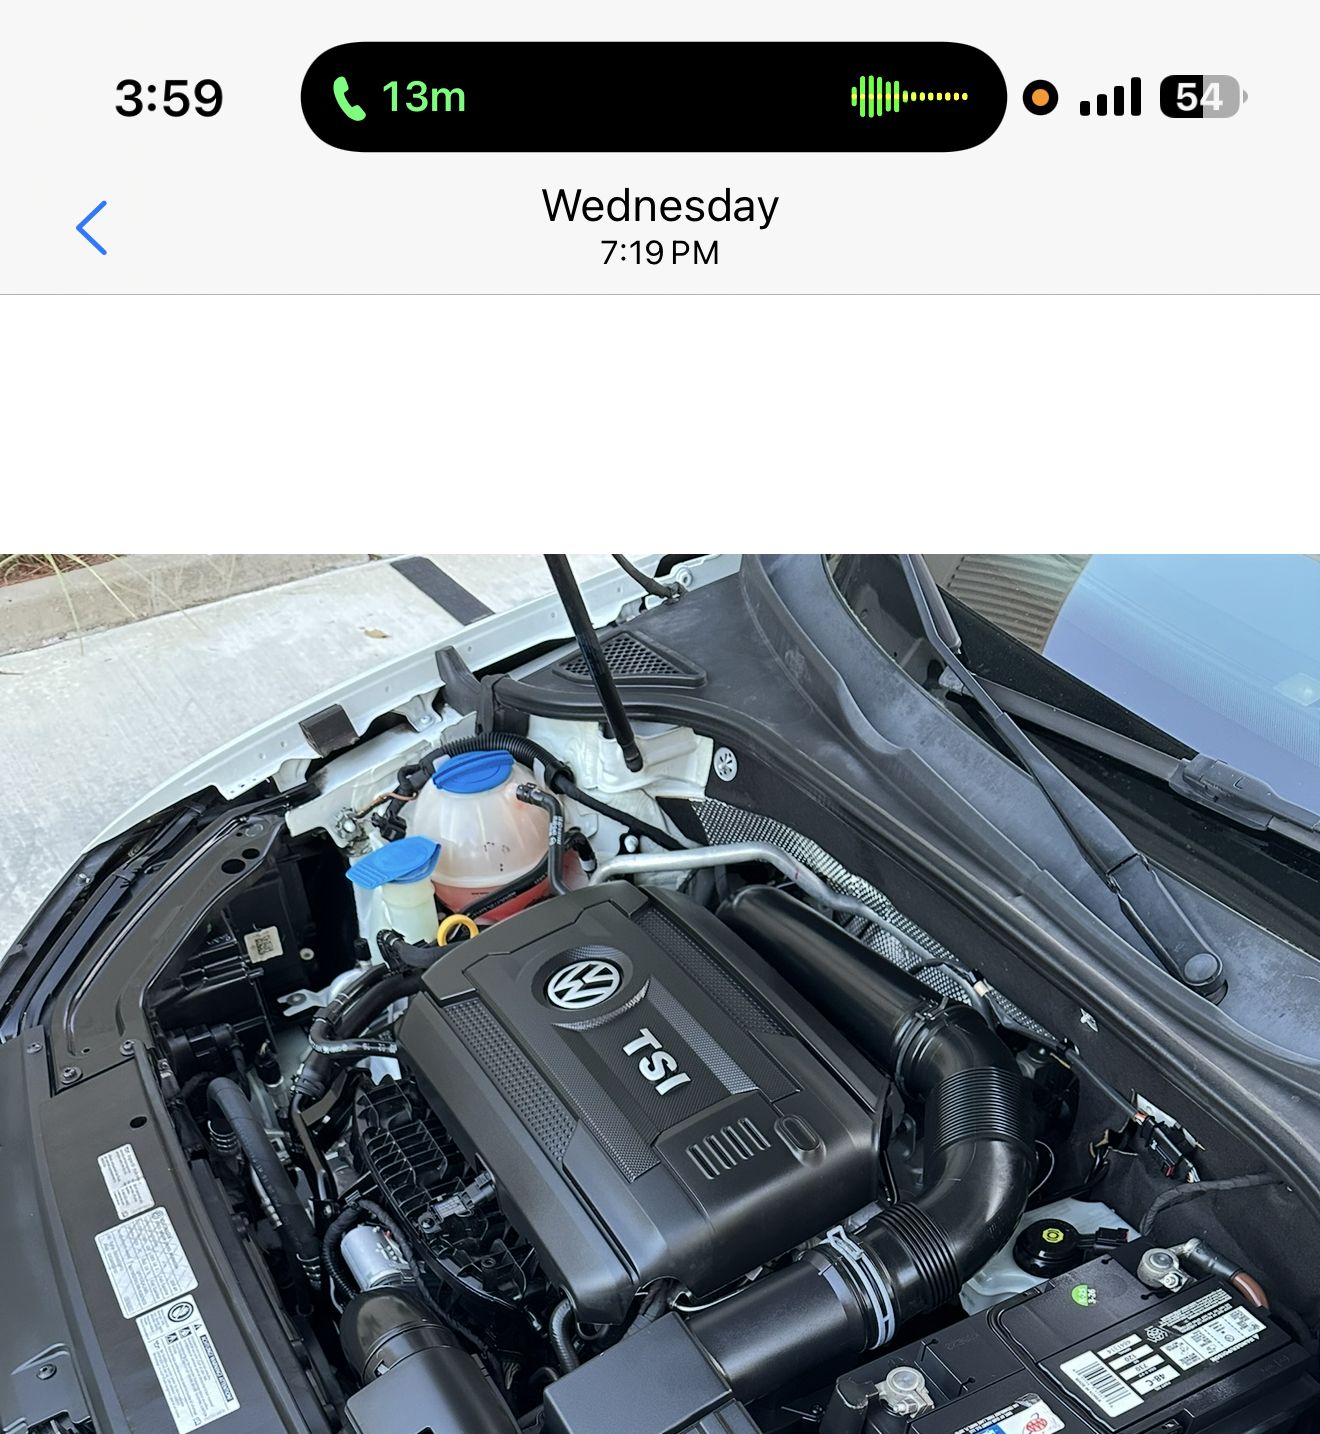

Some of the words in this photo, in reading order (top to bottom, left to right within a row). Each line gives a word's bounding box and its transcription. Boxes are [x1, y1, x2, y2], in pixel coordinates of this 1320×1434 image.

[115, 79, 223, 118] 3:59
[383, 80, 465, 113] 13m
[1176, 82, 1224, 112] 54
[542, 188, 780, 230] Wednesday
[601, 240, 664, 266] 7:19
[673, 240, 719, 265] PM
[622, 1027, 692, 1096] TSI
